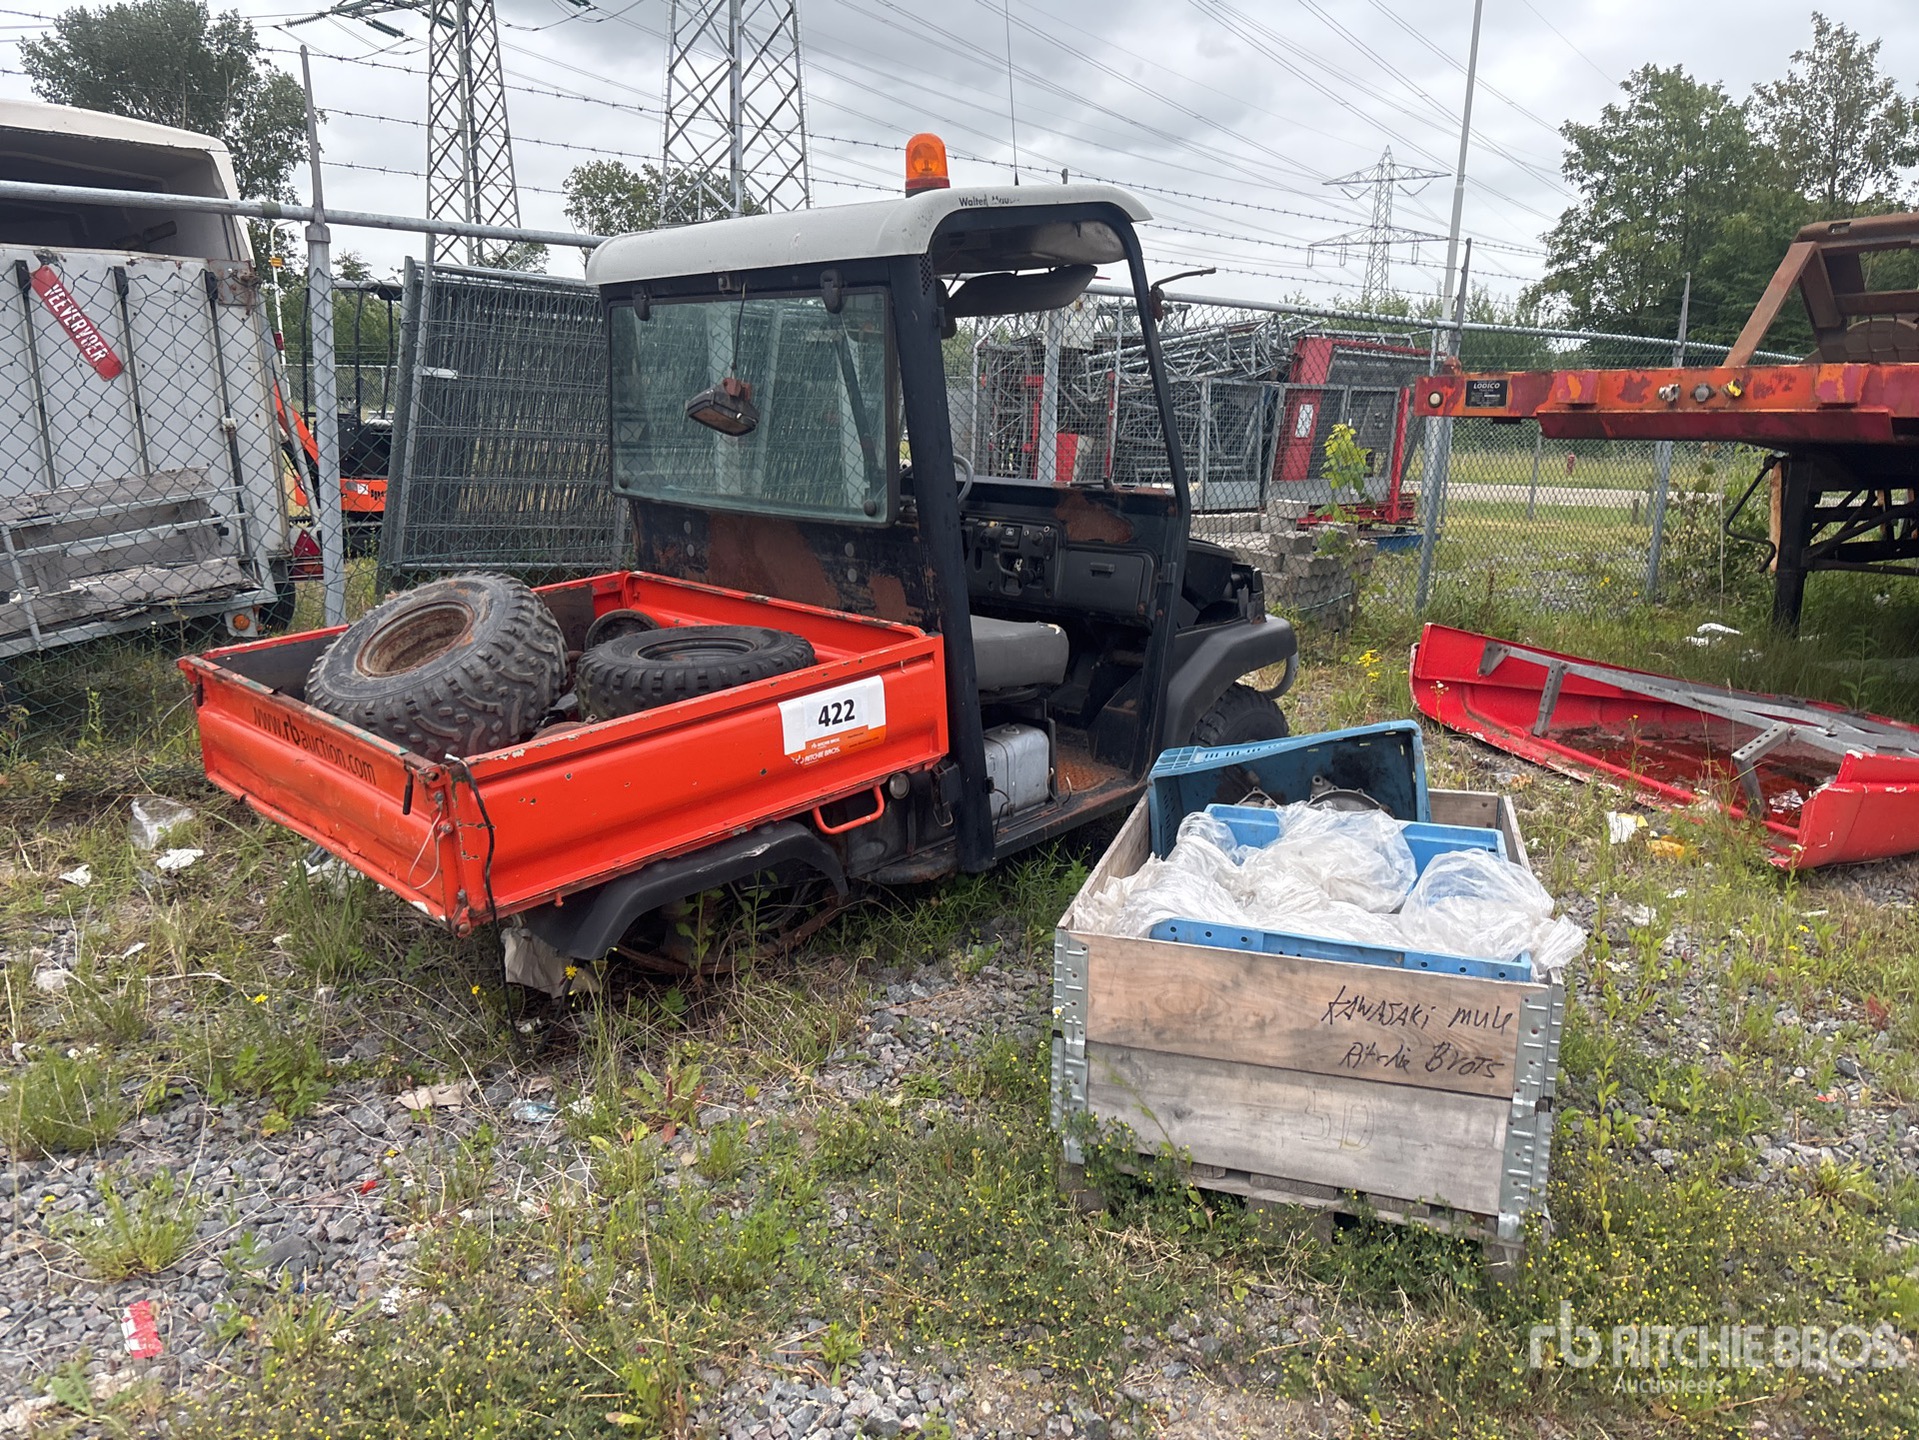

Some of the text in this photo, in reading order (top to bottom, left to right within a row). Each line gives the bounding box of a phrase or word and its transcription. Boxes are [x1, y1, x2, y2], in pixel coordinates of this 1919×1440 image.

[44, 283, 109, 363] VEEVERVOER
[253, 706, 376, 786] www.rbauction.com
[818, 699, 856, 727] 422
